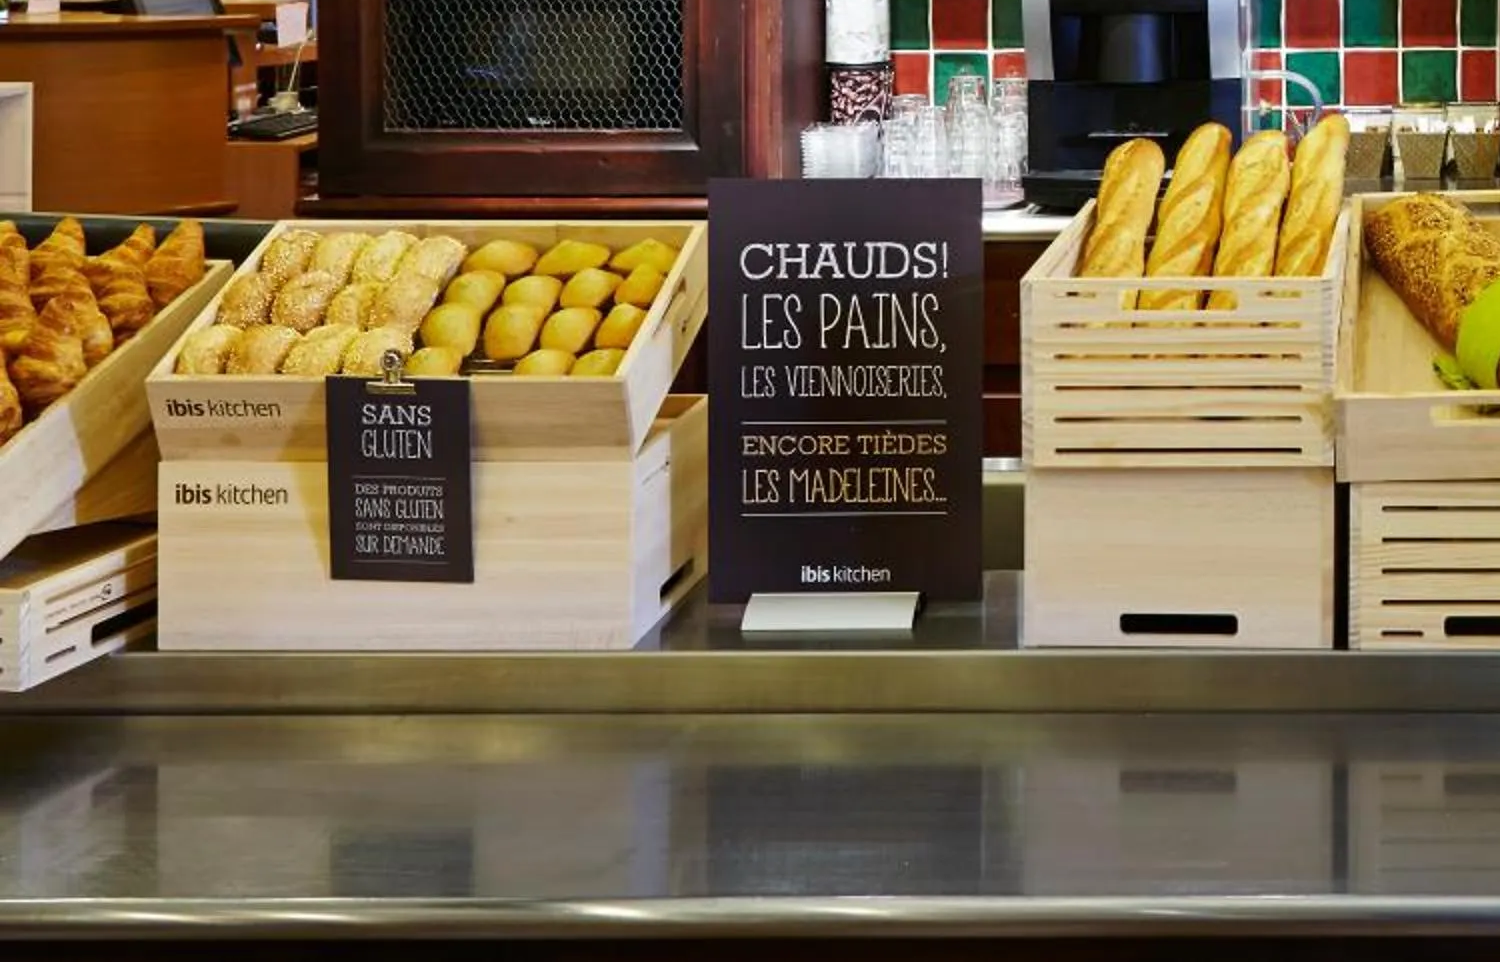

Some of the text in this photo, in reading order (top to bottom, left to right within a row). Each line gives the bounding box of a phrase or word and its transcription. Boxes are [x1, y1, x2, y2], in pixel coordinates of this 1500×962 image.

[739, 241, 949, 280] CHAUDS!
[741, 292, 948, 353] LES PAINS,
[741, 365, 776, 398] LES
[166, 399, 281, 418] ibis kitchen
[361, 404, 432, 426] SANS
[361, 429, 433, 459] GLUTEN
[742, 430, 947, 456] ENCORE TIÈDES
[175, 483, 289, 505] ibis kitchen
[354, 483, 444, 497] DES PRODUITS
[742, 469, 780, 505] LES
[354, 497, 444, 520] SANS GLUTEN
[355, 535, 445, 556] SUR DEMANDE
[801, 565, 891, 583] ibis kitchen
